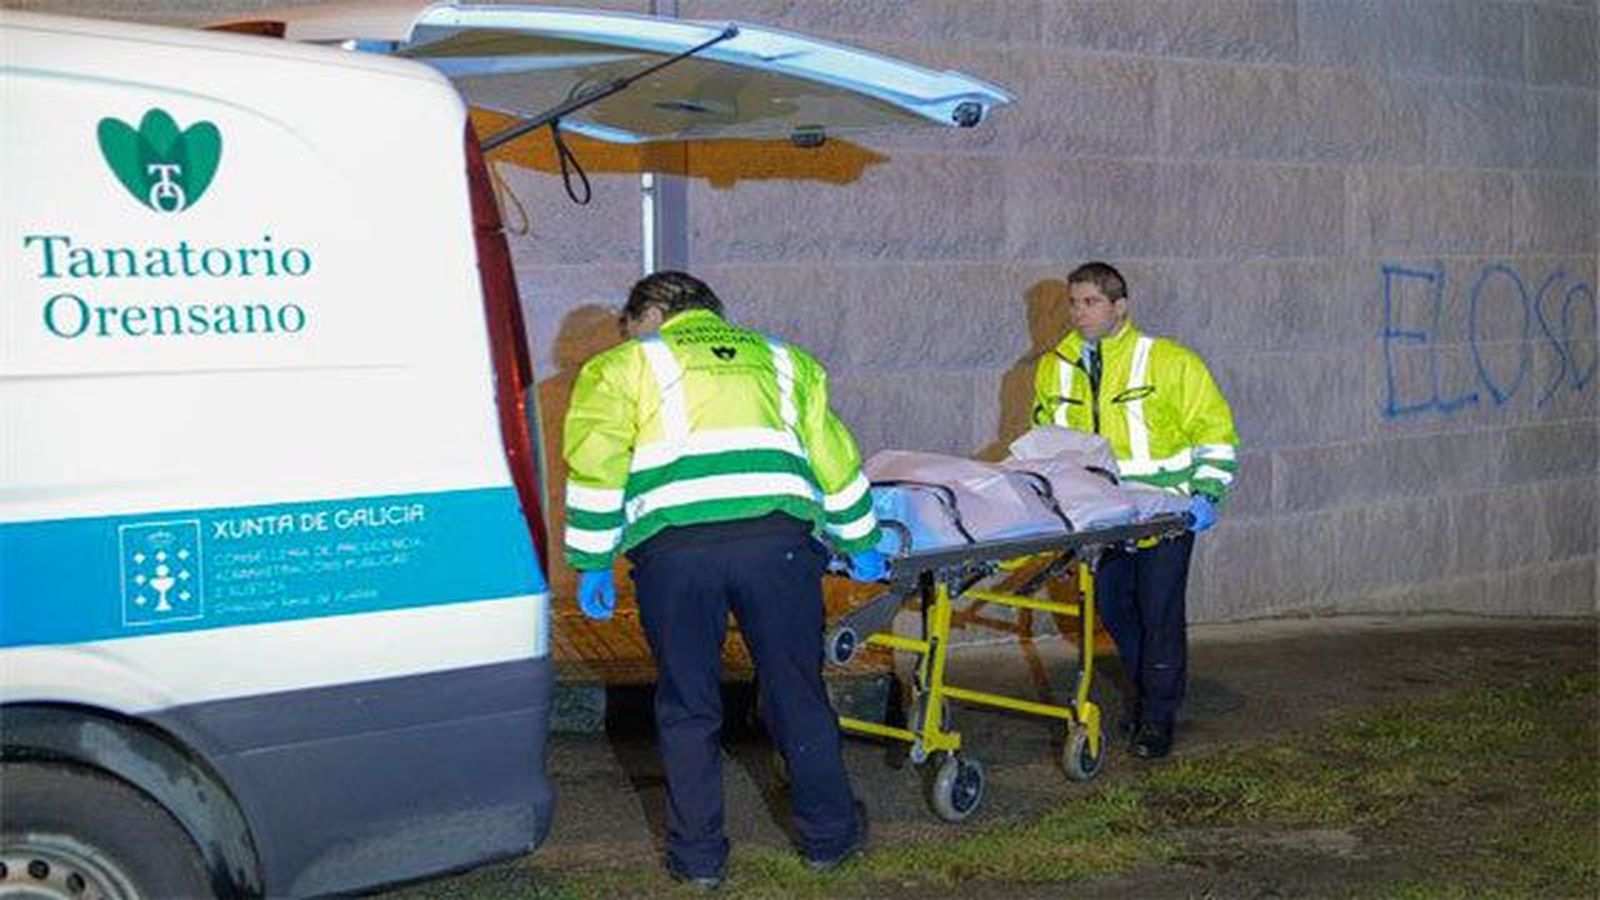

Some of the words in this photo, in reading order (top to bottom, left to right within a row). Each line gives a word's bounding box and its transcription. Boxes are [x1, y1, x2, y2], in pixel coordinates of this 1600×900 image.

[24, 233, 312, 278] Tanatorio
[43, 293, 306, 339] Orensano
[213, 514, 293, 539] XUNTA
[300, 511, 329, 532] DE
[334, 503, 425, 529] GALICIA
